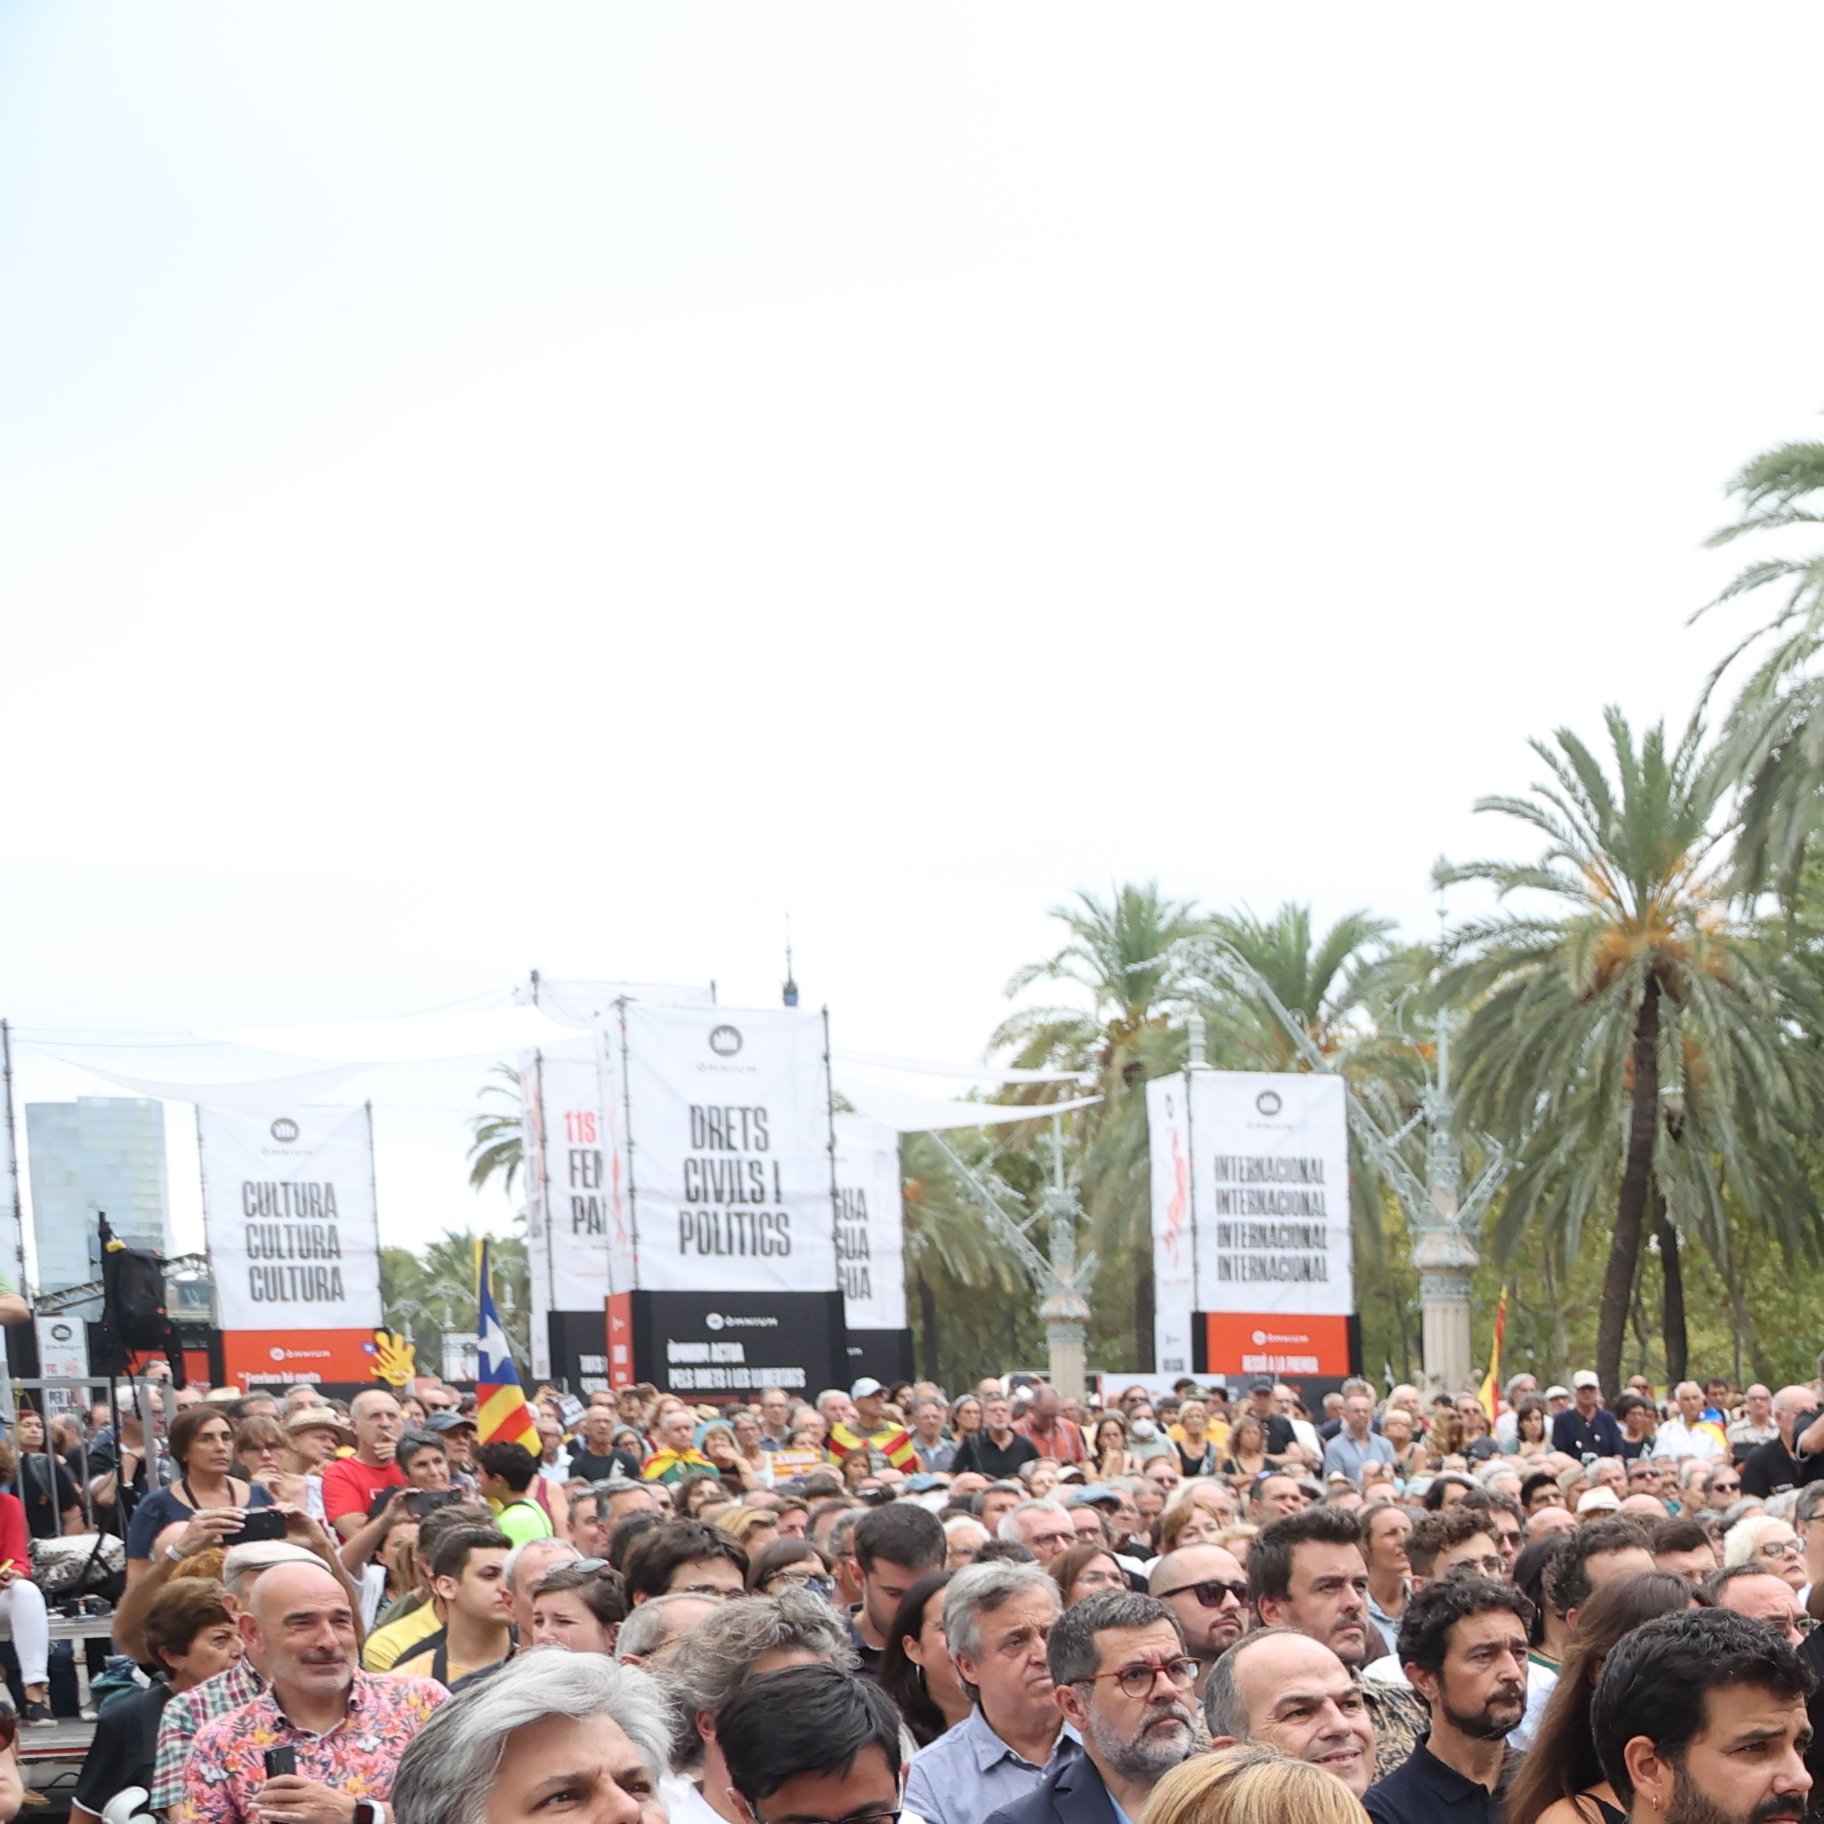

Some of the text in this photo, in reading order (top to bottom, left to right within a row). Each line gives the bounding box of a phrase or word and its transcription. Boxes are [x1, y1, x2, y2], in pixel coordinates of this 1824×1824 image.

[563, 1111, 596, 1143] 11S
[690, 1105, 769, 1151] DRETS
[684, 1157, 782, 1204] CIVILS I
[1214, 1155, 1325, 1184] INTERNACIONAL
[242, 1181, 340, 1219] CULTURA
[1216, 1187, 1327, 1217] INTERNACIONAL
[245, 1223, 343, 1260] CULTURA
[679, 1201, 792, 1257] POLÍTICS
[1217, 1221, 1328, 1250] INTERNACIONAL
[248, 1265, 346, 1303] CULTURA
[1217, 1255, 1329, 1283] INTERNACIONAL
